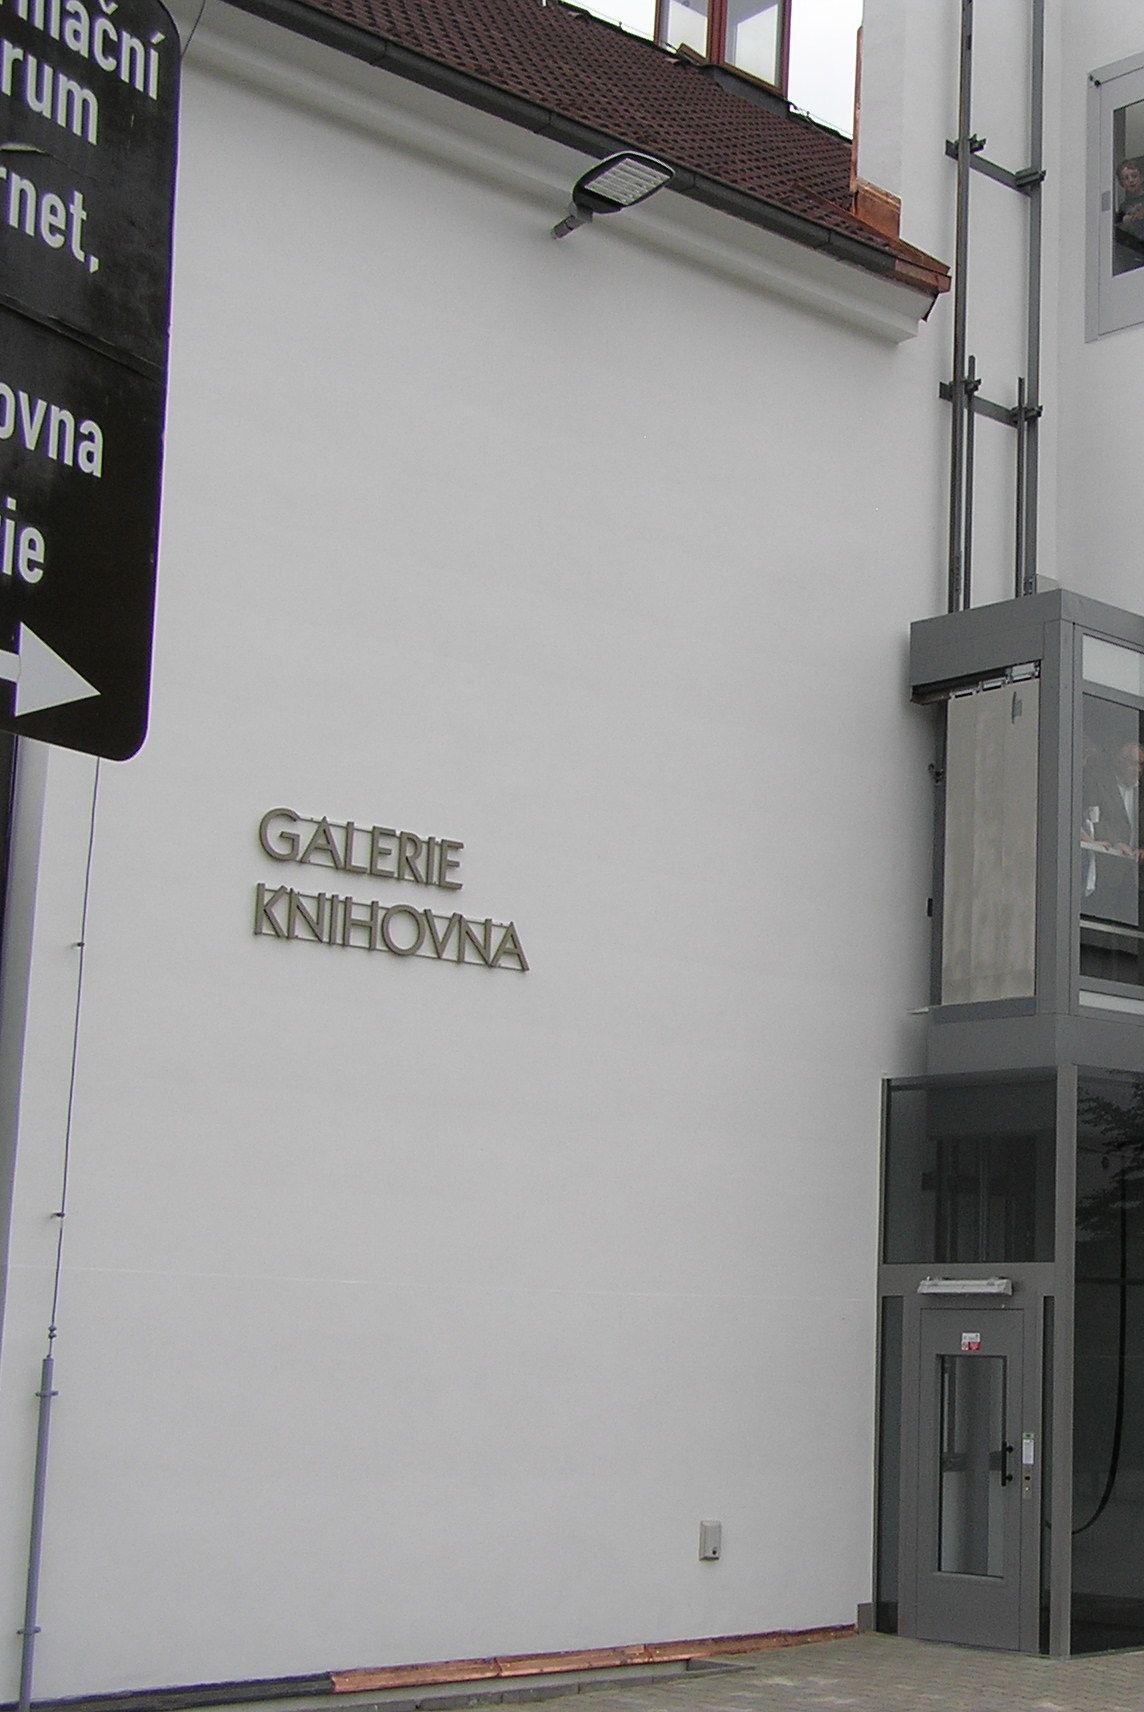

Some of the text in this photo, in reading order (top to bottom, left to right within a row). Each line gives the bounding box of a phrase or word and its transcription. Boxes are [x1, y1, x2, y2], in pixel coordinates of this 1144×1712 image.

[1, 38, 99, 146] rum
[258, 806, 465, 890] GALERIE
[254, 882, 531, 972] KNIHOVNA
